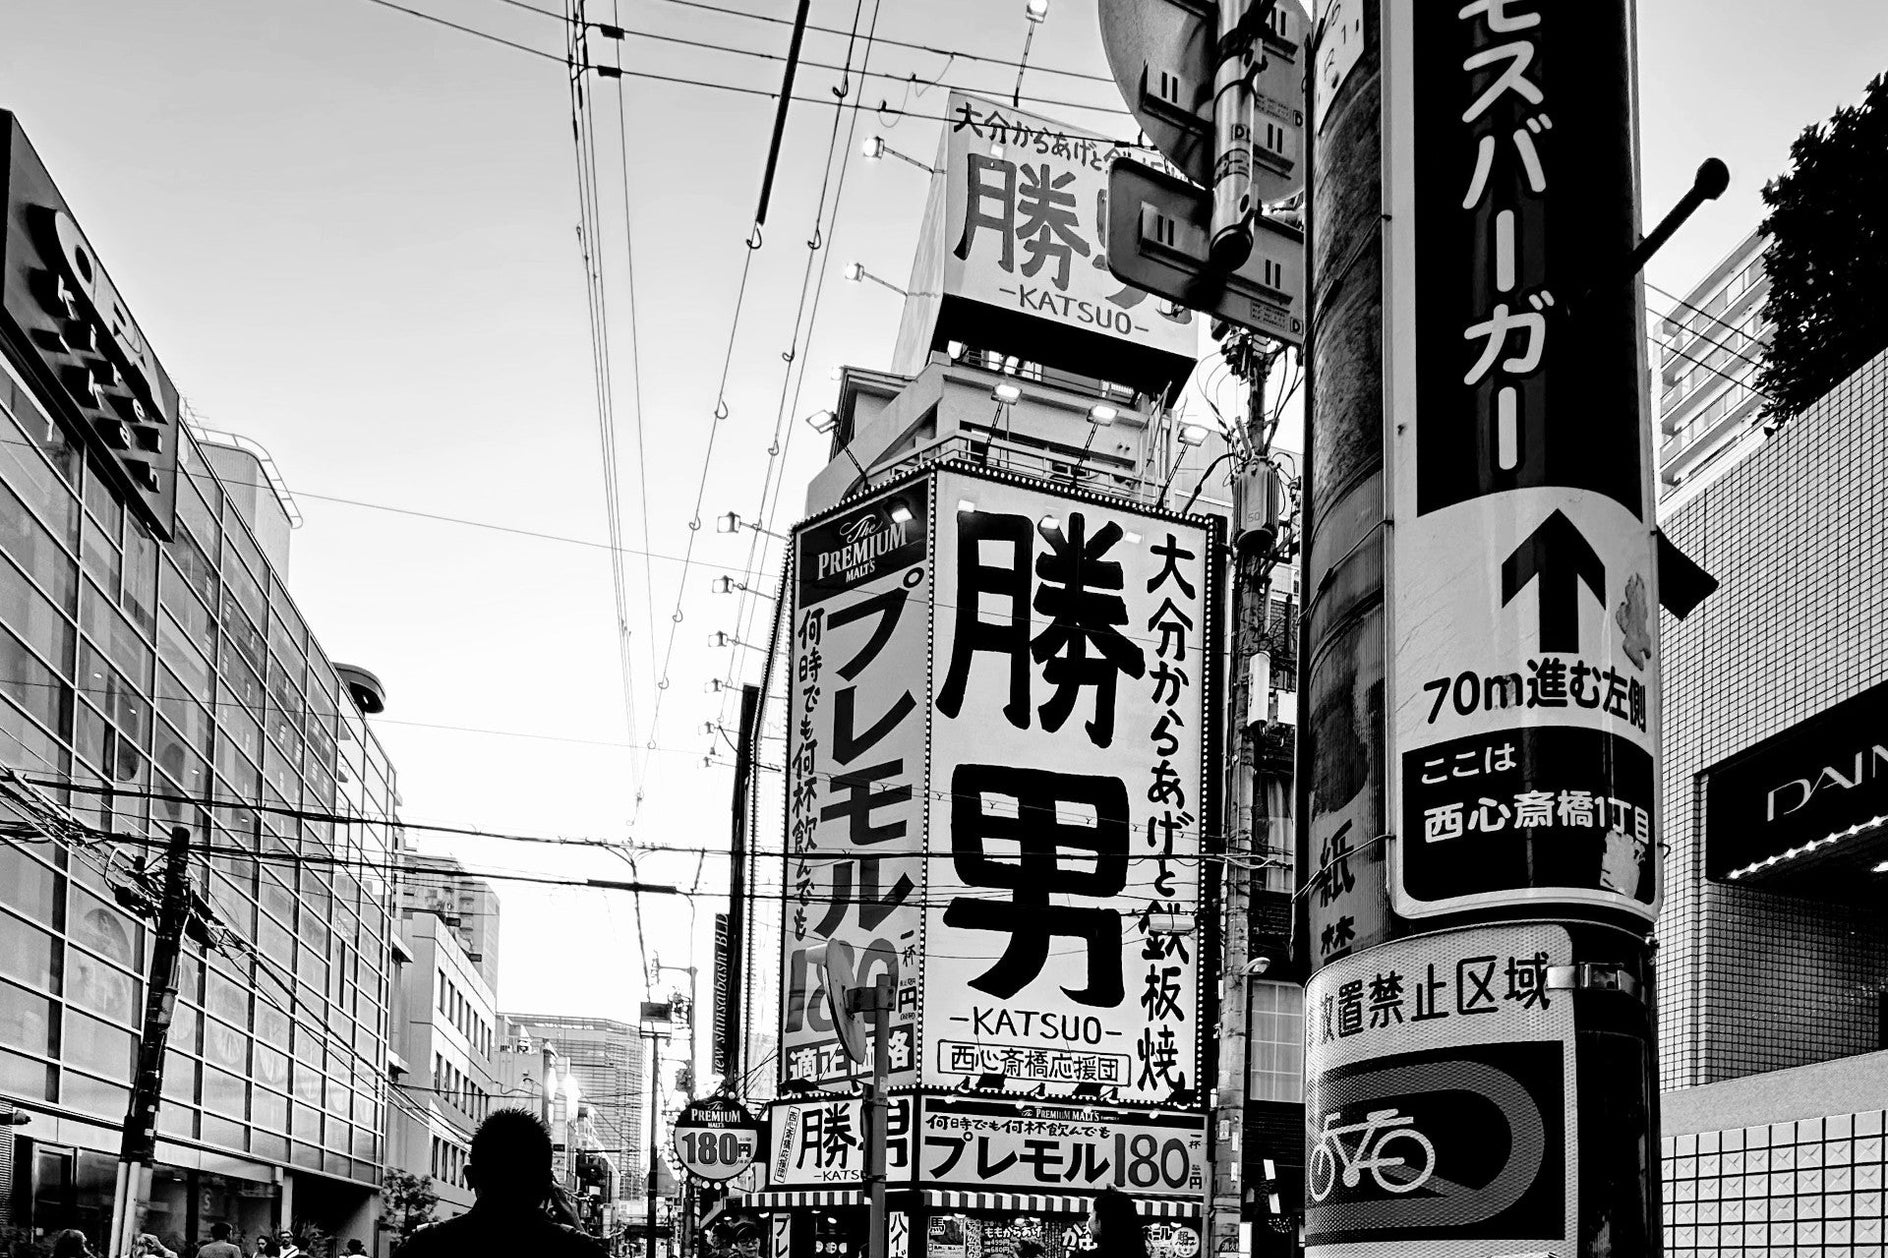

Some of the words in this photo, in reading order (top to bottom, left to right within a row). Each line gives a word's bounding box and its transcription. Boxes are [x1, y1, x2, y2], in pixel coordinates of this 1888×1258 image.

[817, 522, 908, 581] PREMIUM
[839, 514, 884, 544] The
[1423, 657, 1647, 733] 70m進む左側
[791, 607, 824, 942] 何時でも何杯飲んでも
[813, 567, 925, 939] プレモル
[935, 511, 1146, 1008] 勝男
[1421, 742, 1517, 785] ここは
[1137, 533, 1196, 1091] 大分からあげと鉄板焼
[1422, 789, 1650, 845] 西心斎橋1丁目
[714, 953, 728, 1044] shinsaibashi
[951, 1045, 1119, 1082] 西心斎橋応援団
[691, 1108, 741, 1123] PREMIUM
[925, 1114, 1111, 1139] 何時でも何杯飲んでも
[1036, 1108, 1070, 1120] PREMIUM
[682, 1132, 738, 1165] 180
[925, 1131, 1111, 1184] プレモル
[1114, 1133, 1190, 1189] 180
[984, 1226, 1043, 1238] ももからあげ
